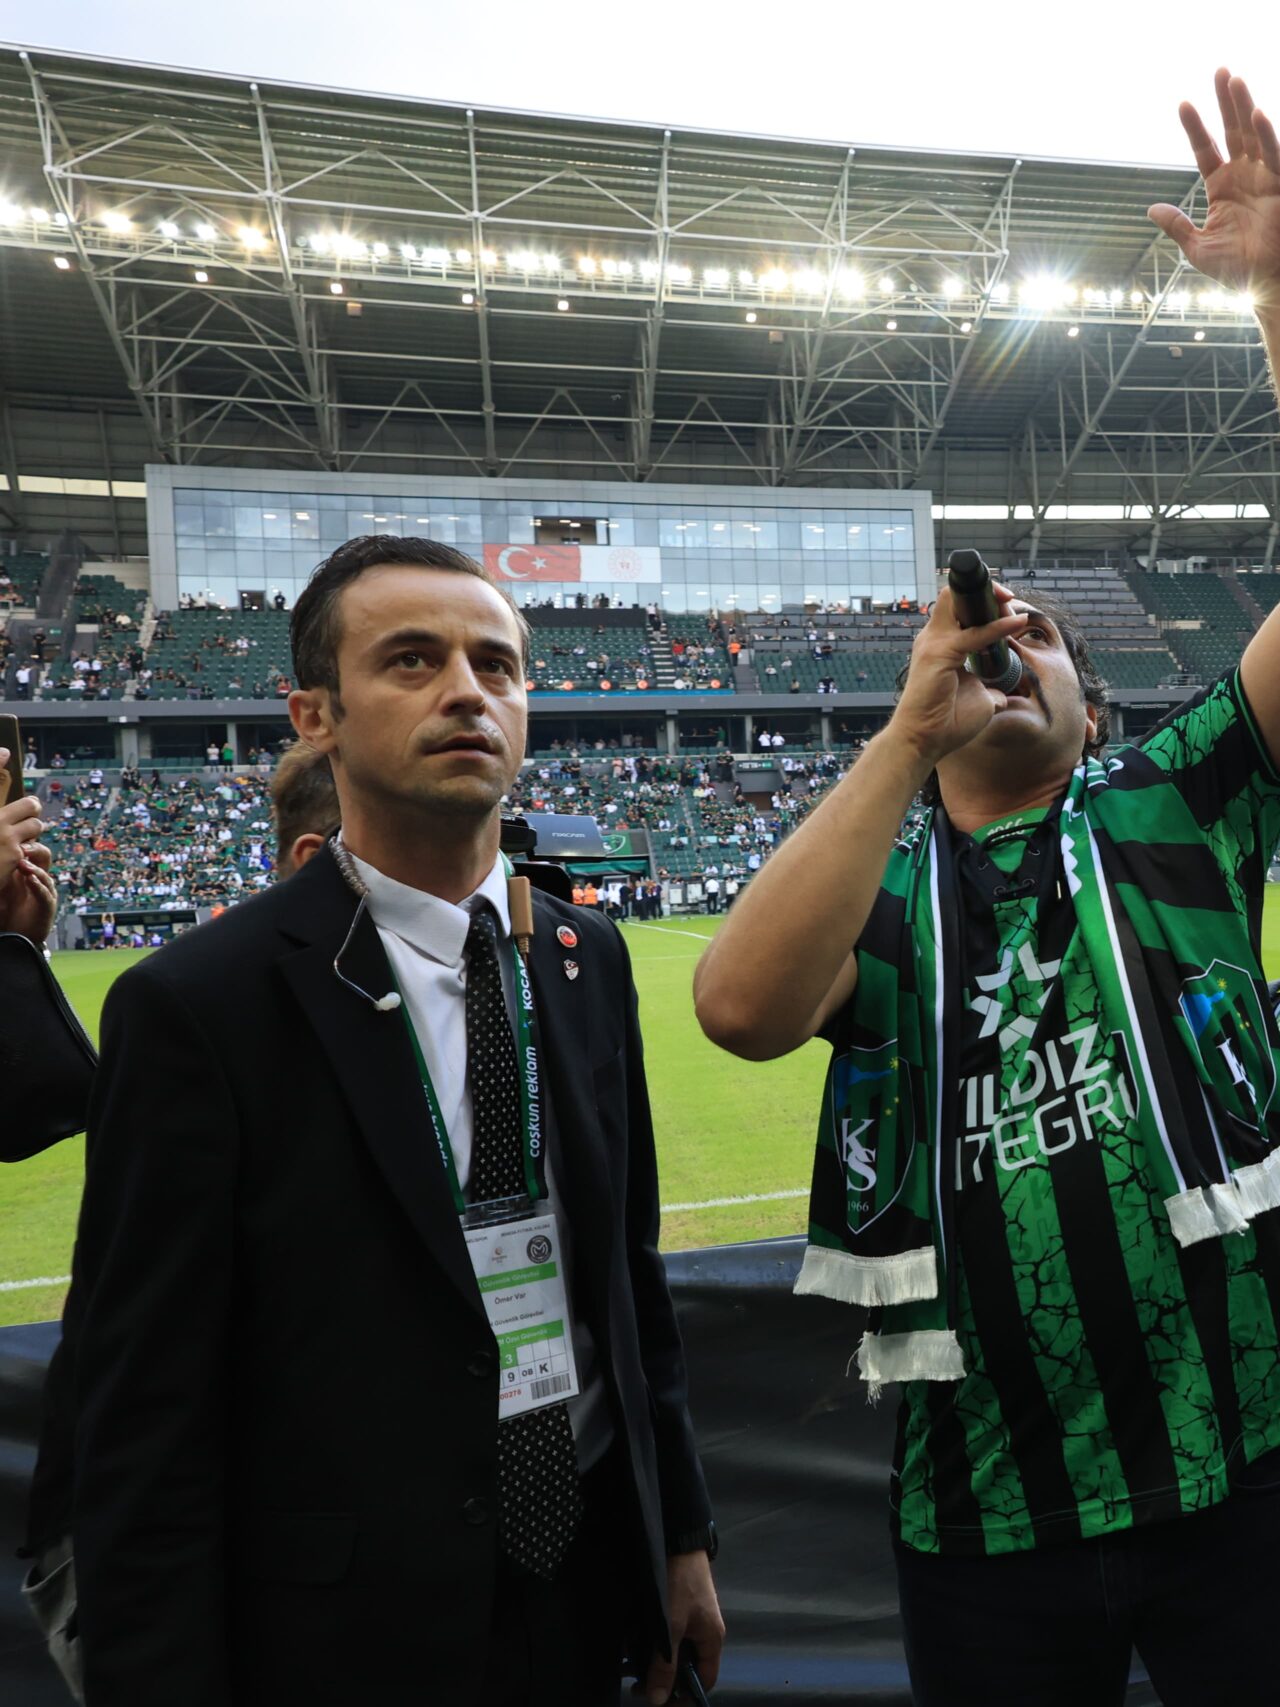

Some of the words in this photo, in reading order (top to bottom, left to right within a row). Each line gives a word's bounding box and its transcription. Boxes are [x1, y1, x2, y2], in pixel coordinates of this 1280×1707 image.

[525, 1046, 539, 1100] reklam
[959, 1023, 1111, 1128] ILDIZ
[847, 1201, 870, 1212] 1966
[505, 1354, 513, 1364] 3
[507, 1372, 515, 1382] 9
[539, 1363, 549, 1374] K
